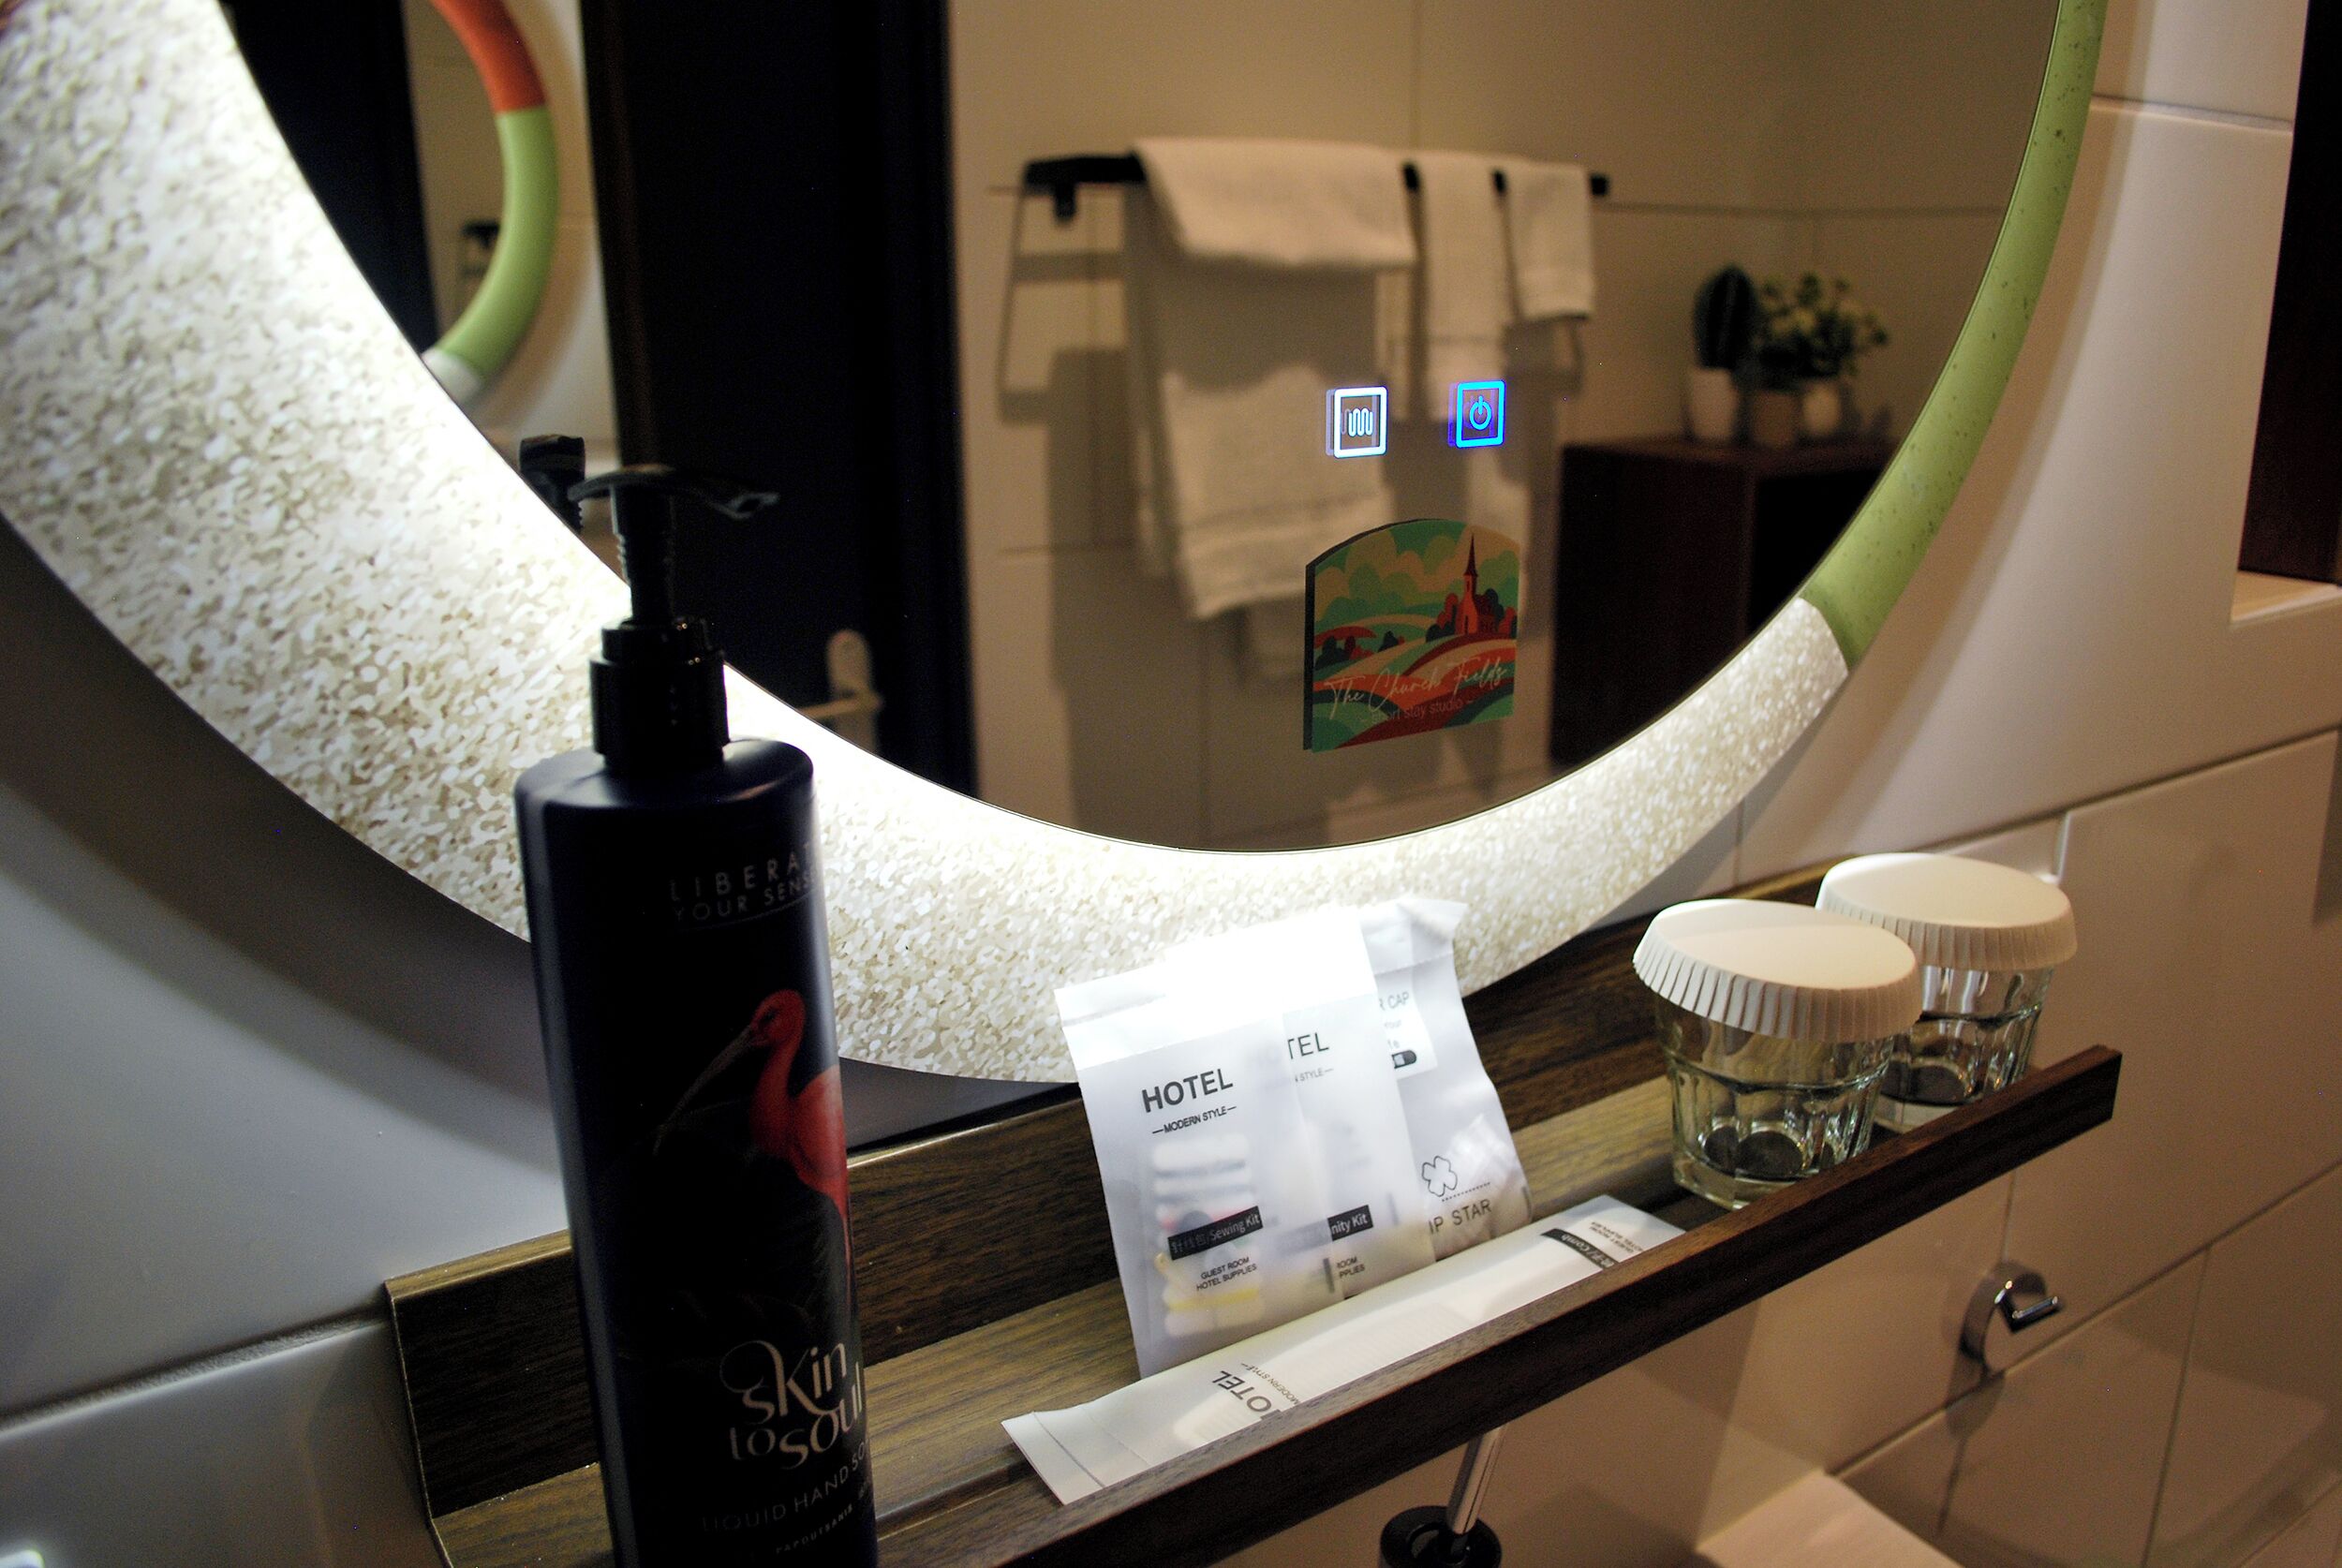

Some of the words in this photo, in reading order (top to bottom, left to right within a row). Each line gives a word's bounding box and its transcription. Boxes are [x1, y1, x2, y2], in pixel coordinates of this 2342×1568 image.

[1324, 674, 1366, 719] The
[1369, 667, 1441, 712] Church
[1403, 704, 1427, 719] stay
[1429, 697, 1464, 715] studio
[671, 895, 749, 921] YOUR
[1387, 991, 1410, 1012] CAP
[1141, 1068, 1234, 1113] HOTEL
[1164, 1113, 1202, 1134] MODERN
[1203, 1106, 1227, 1122] STYLE
[1246, 1214, 1261, 1229] Kit
[1331, 1216, 1352, 1235] nity
[1352, 1212, 1369, 1227] Kit
[1429, 1215, 1444, 1235] IP
[1451, 1198, 1492, 1227] STAR
[1196, 1276, 1222, 1292] HOTEL
[1222, 1264, 1258, 1285] SUPPLIES
[1200, 1263, 1226, 1280] GUEST
[1226, 1256, 1250, 1270] ROOM
[1339, 1265, 1365, 1279] PPLIES
[702, 1502, 787, 1534] LIQUID
[793, 1465, 850, 1514] HAND
